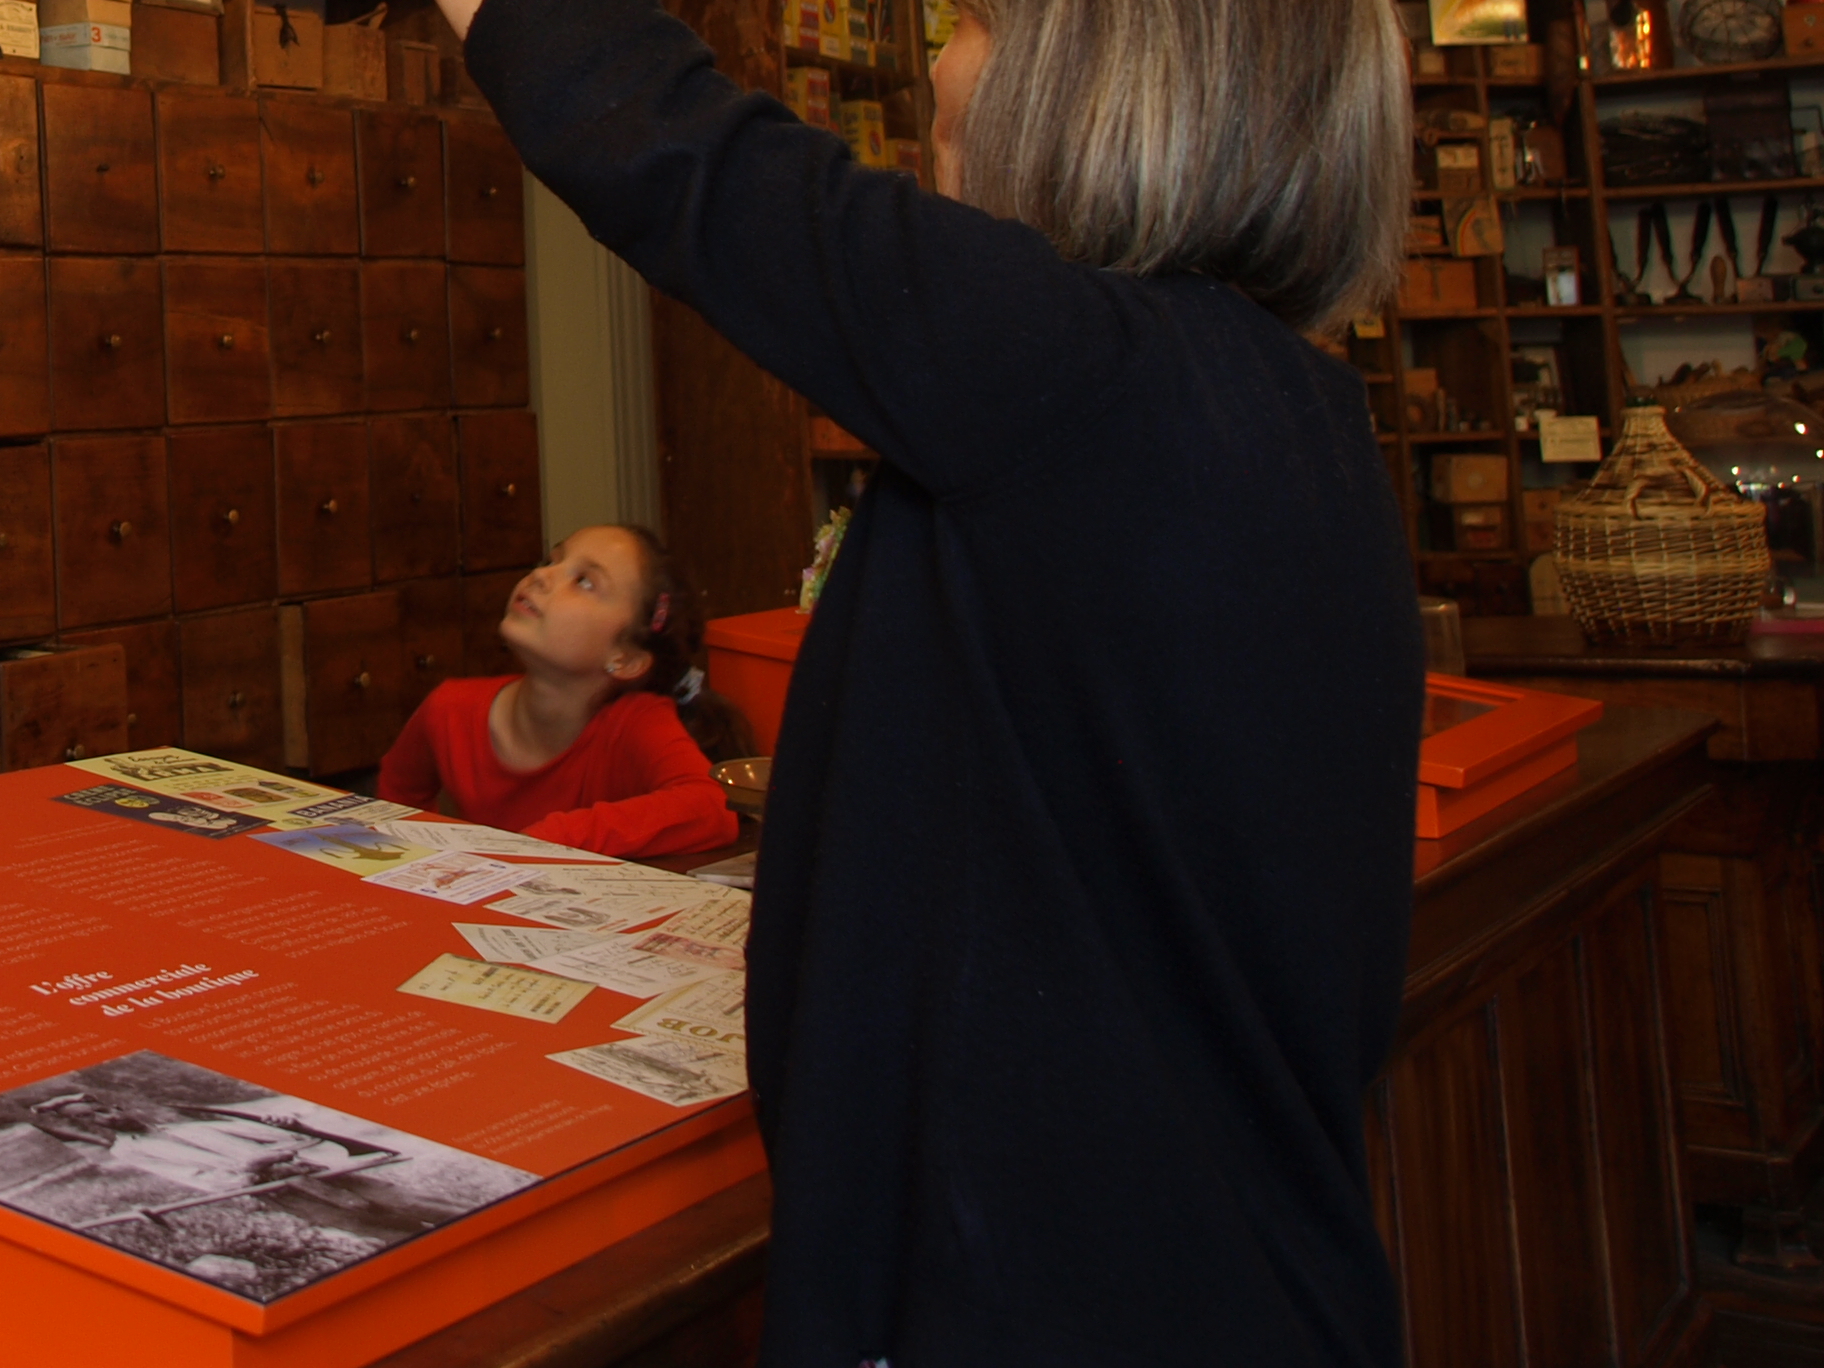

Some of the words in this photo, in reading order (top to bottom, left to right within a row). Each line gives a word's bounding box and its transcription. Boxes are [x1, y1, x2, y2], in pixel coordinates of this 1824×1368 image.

[92, 27, 101, 42] 3
[293, 795, 377, 817] BANANIA
[29, 968, 114, 997] L'offre
[68, 961, 212, 1008] commerciale
[101, 1004, 135, 1017] de
[137, 995, 164, 1010] la
[165, 967, 260, 1001] boutique
